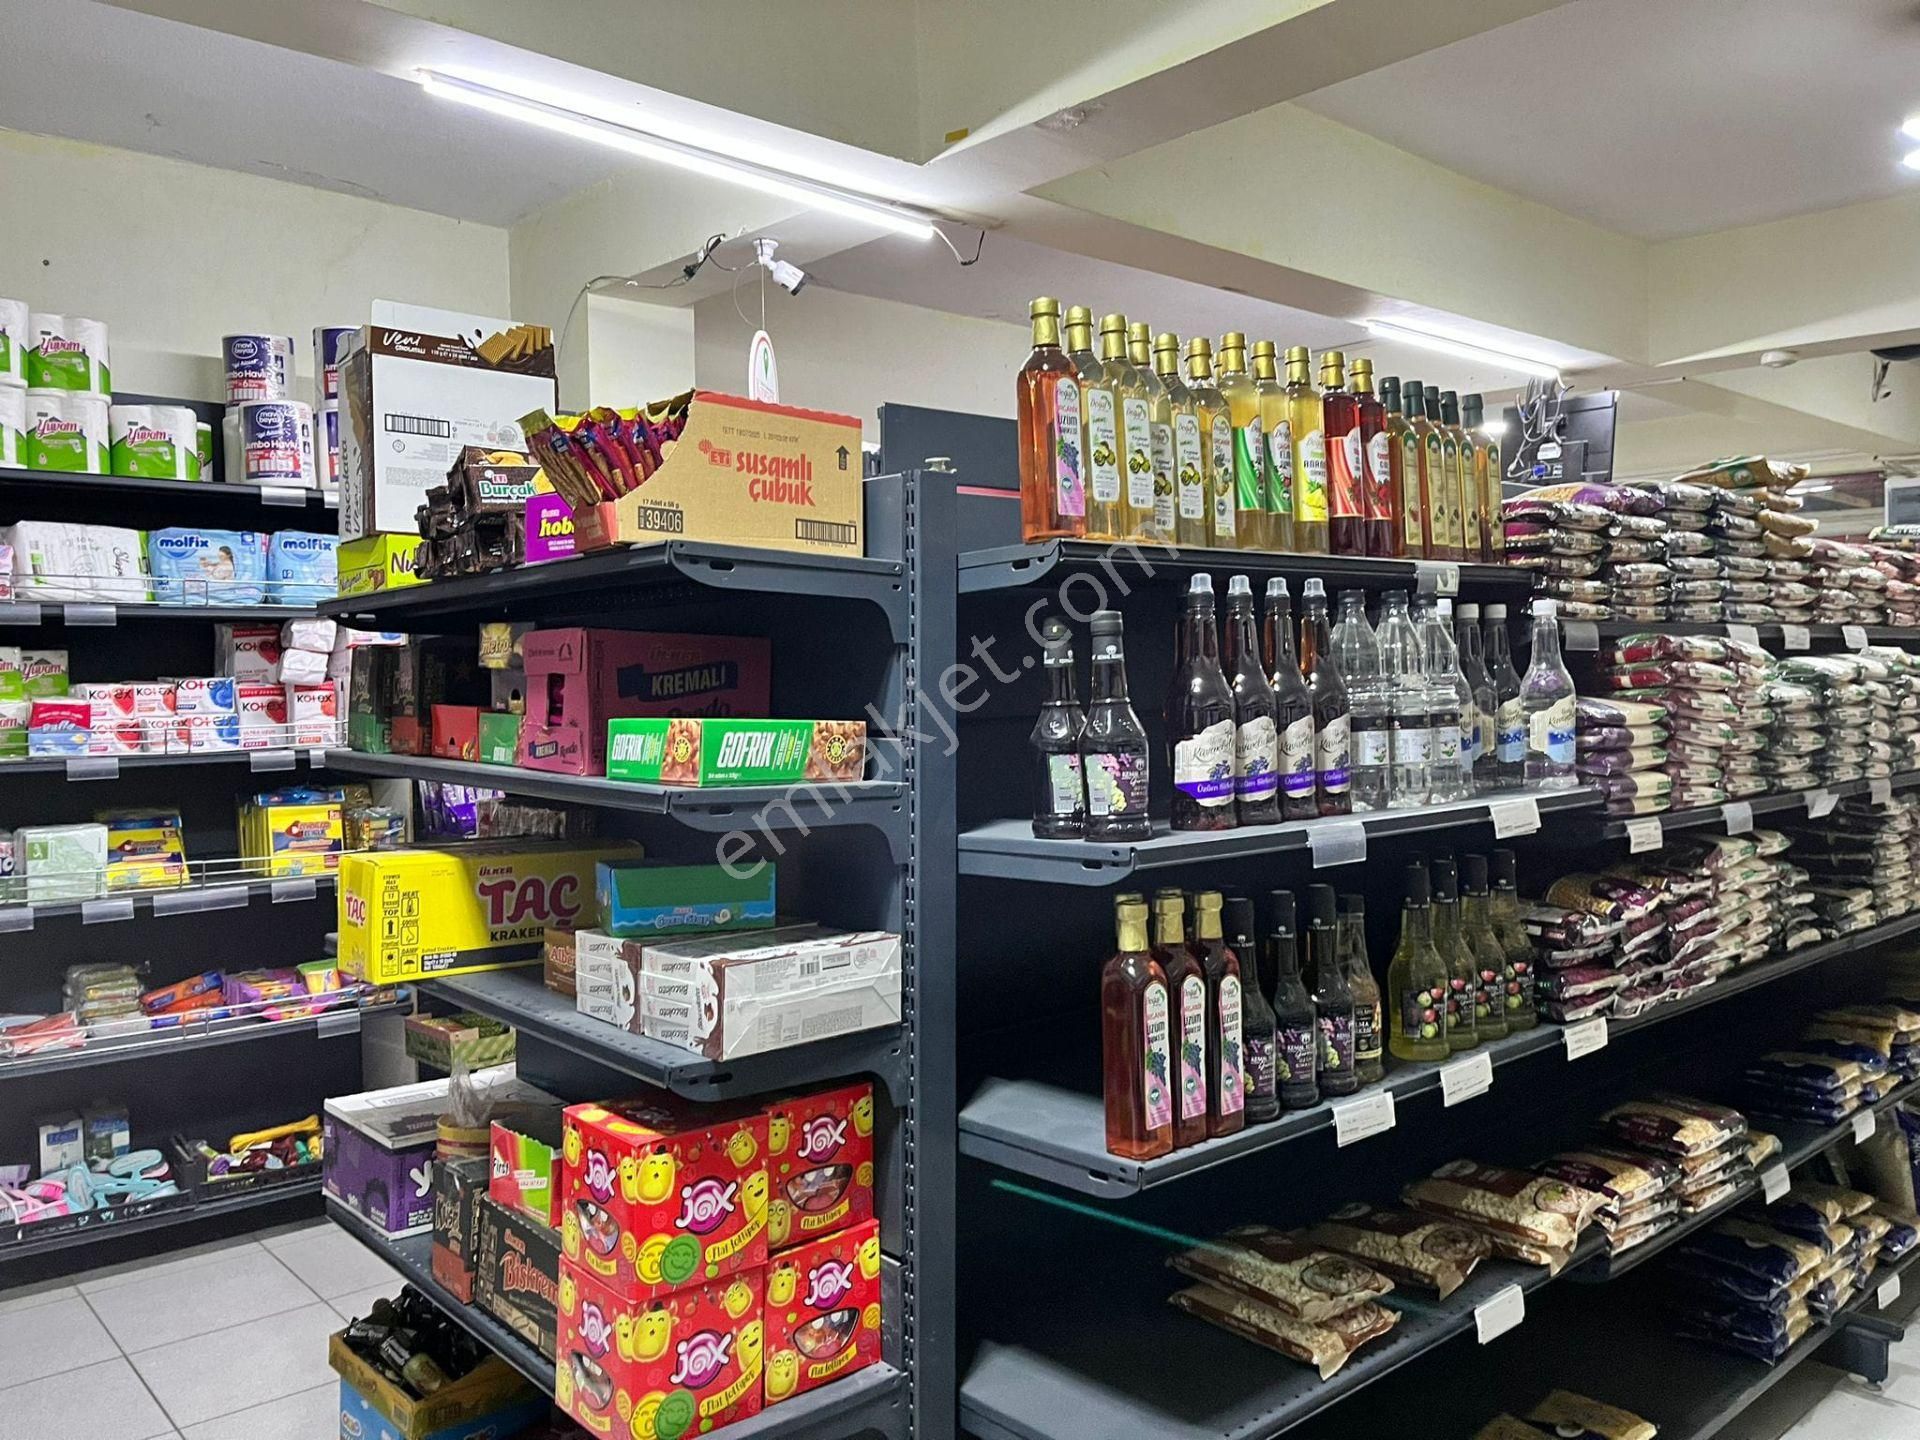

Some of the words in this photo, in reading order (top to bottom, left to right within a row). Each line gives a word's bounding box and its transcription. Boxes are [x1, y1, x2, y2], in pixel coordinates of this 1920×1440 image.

[40, 337, 81, 356] Yuvam
[37, 418, 78, 438] Yuvam
[127, 427, 167, 446] Yuvam
[710, 451, 730, 465] ETi
[736, 451, 812, 481] susamlı
[479, 480, 536, 499] Burçak
[748, 478, 816, 507] Çubuk
[646, 509, 682, 532] 39406
[159, 536, 209, 548] molfix
[282, 538, 332, 551] molfix
[652, 666, 726, 697] KREMALI
[297, 694, 332, 703] Kotex
[716, 731, 777, 769] GOFRiK
[345, 895, 367, 927] TAÇ
[478, 874, 582, 932] TAÇ
[490, 925, 546, 944] KRAKER
